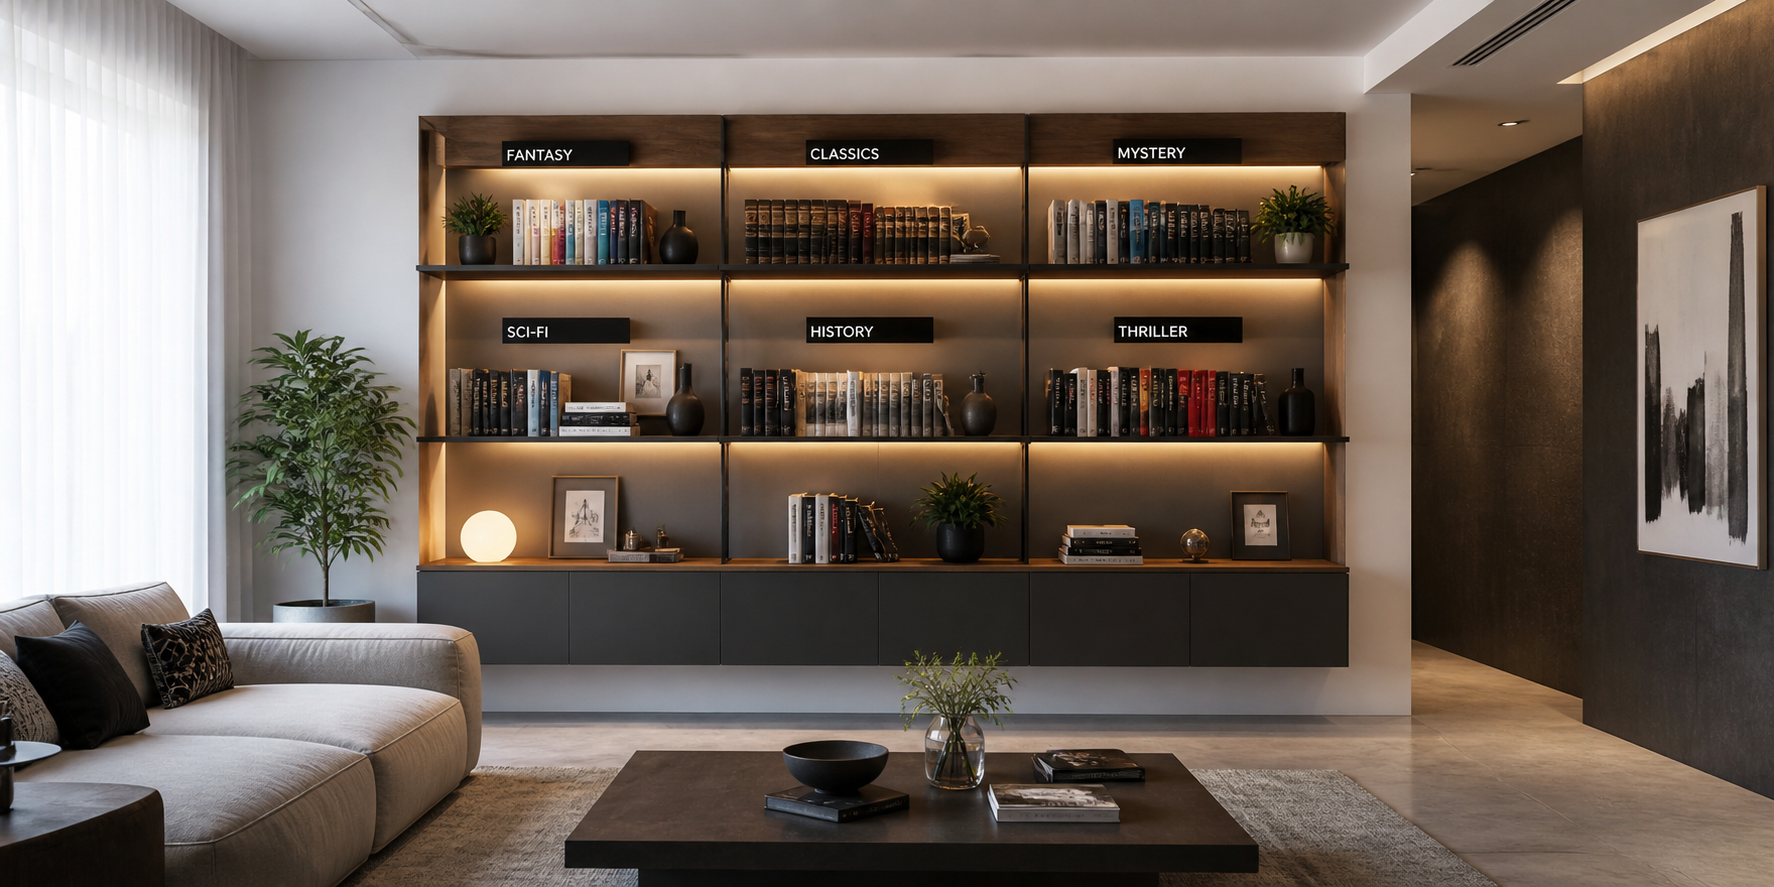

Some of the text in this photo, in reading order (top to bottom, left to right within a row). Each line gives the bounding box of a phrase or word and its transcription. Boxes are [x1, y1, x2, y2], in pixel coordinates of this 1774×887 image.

[507, 148, 572, 161] FANTASY
[811, 147, 880, 160] CLASSICS
[1118, 147, 1186, 159] MYSTERY
[507, 326, 549, 338] SCI-FI
[811, 326, 874, 338] HISTORY
[1118, 326, 1187, 338] THRILLER
